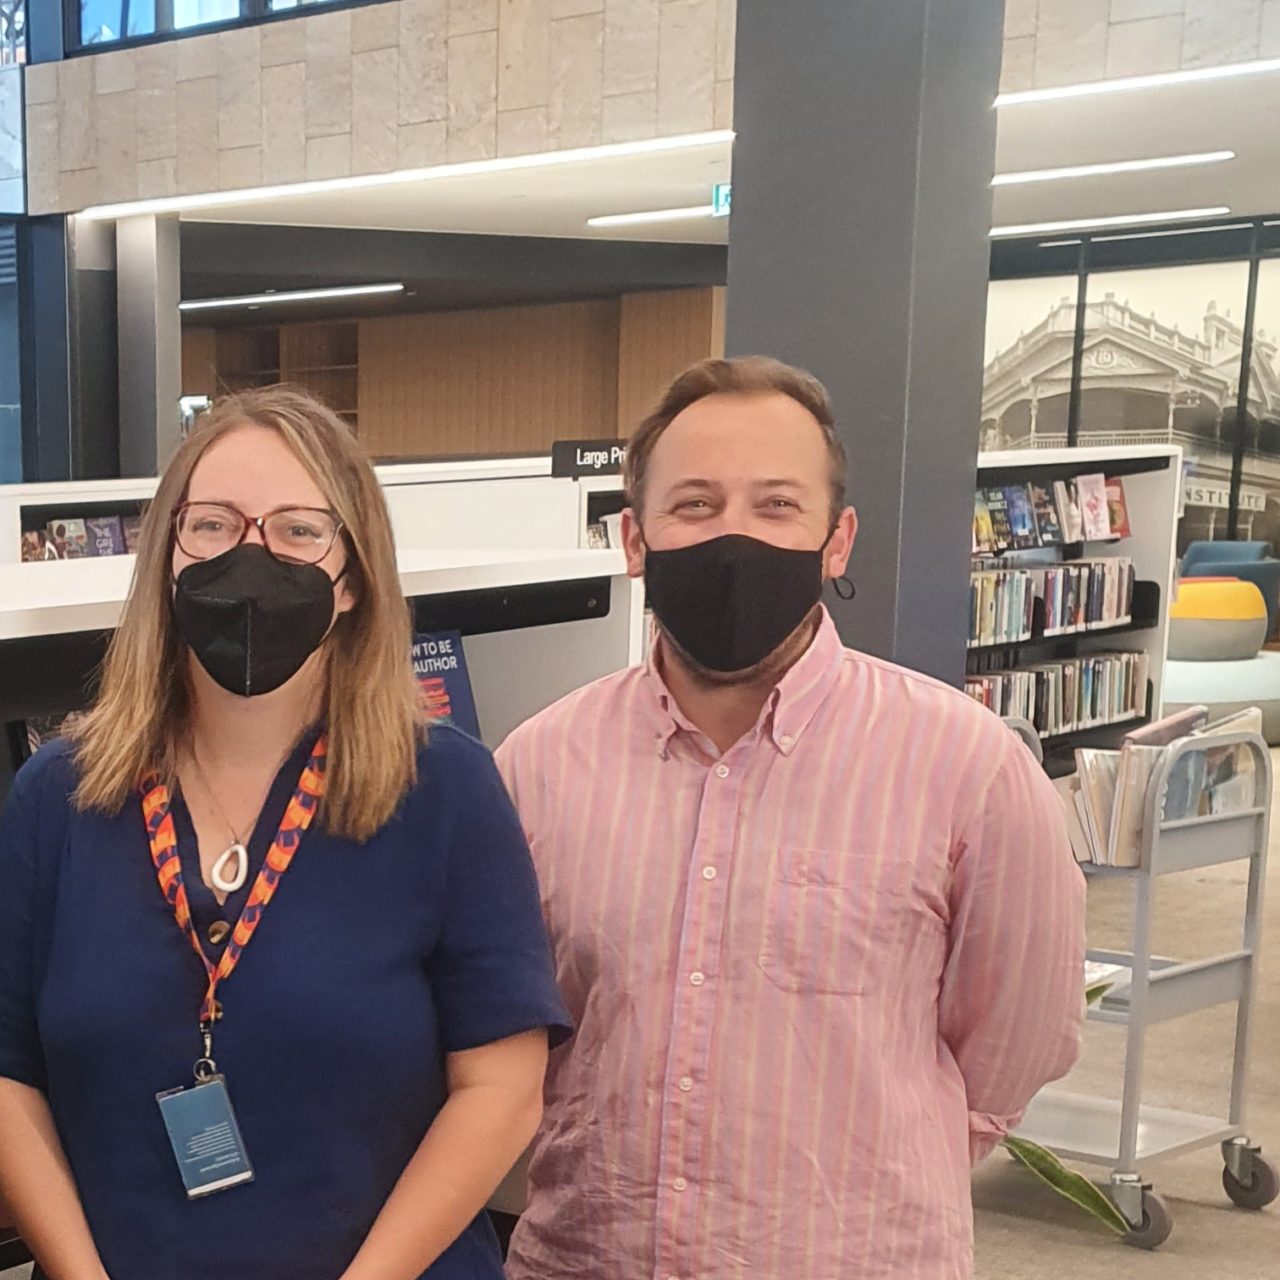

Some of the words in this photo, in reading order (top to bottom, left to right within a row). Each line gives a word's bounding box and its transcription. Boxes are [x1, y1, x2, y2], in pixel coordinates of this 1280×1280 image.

[576, 447, 608, 469] Large
[422, 642, 438, 656] TO
[439, 640, 453, 653] BE
[414, 656, 458, 673] AUTHOR
